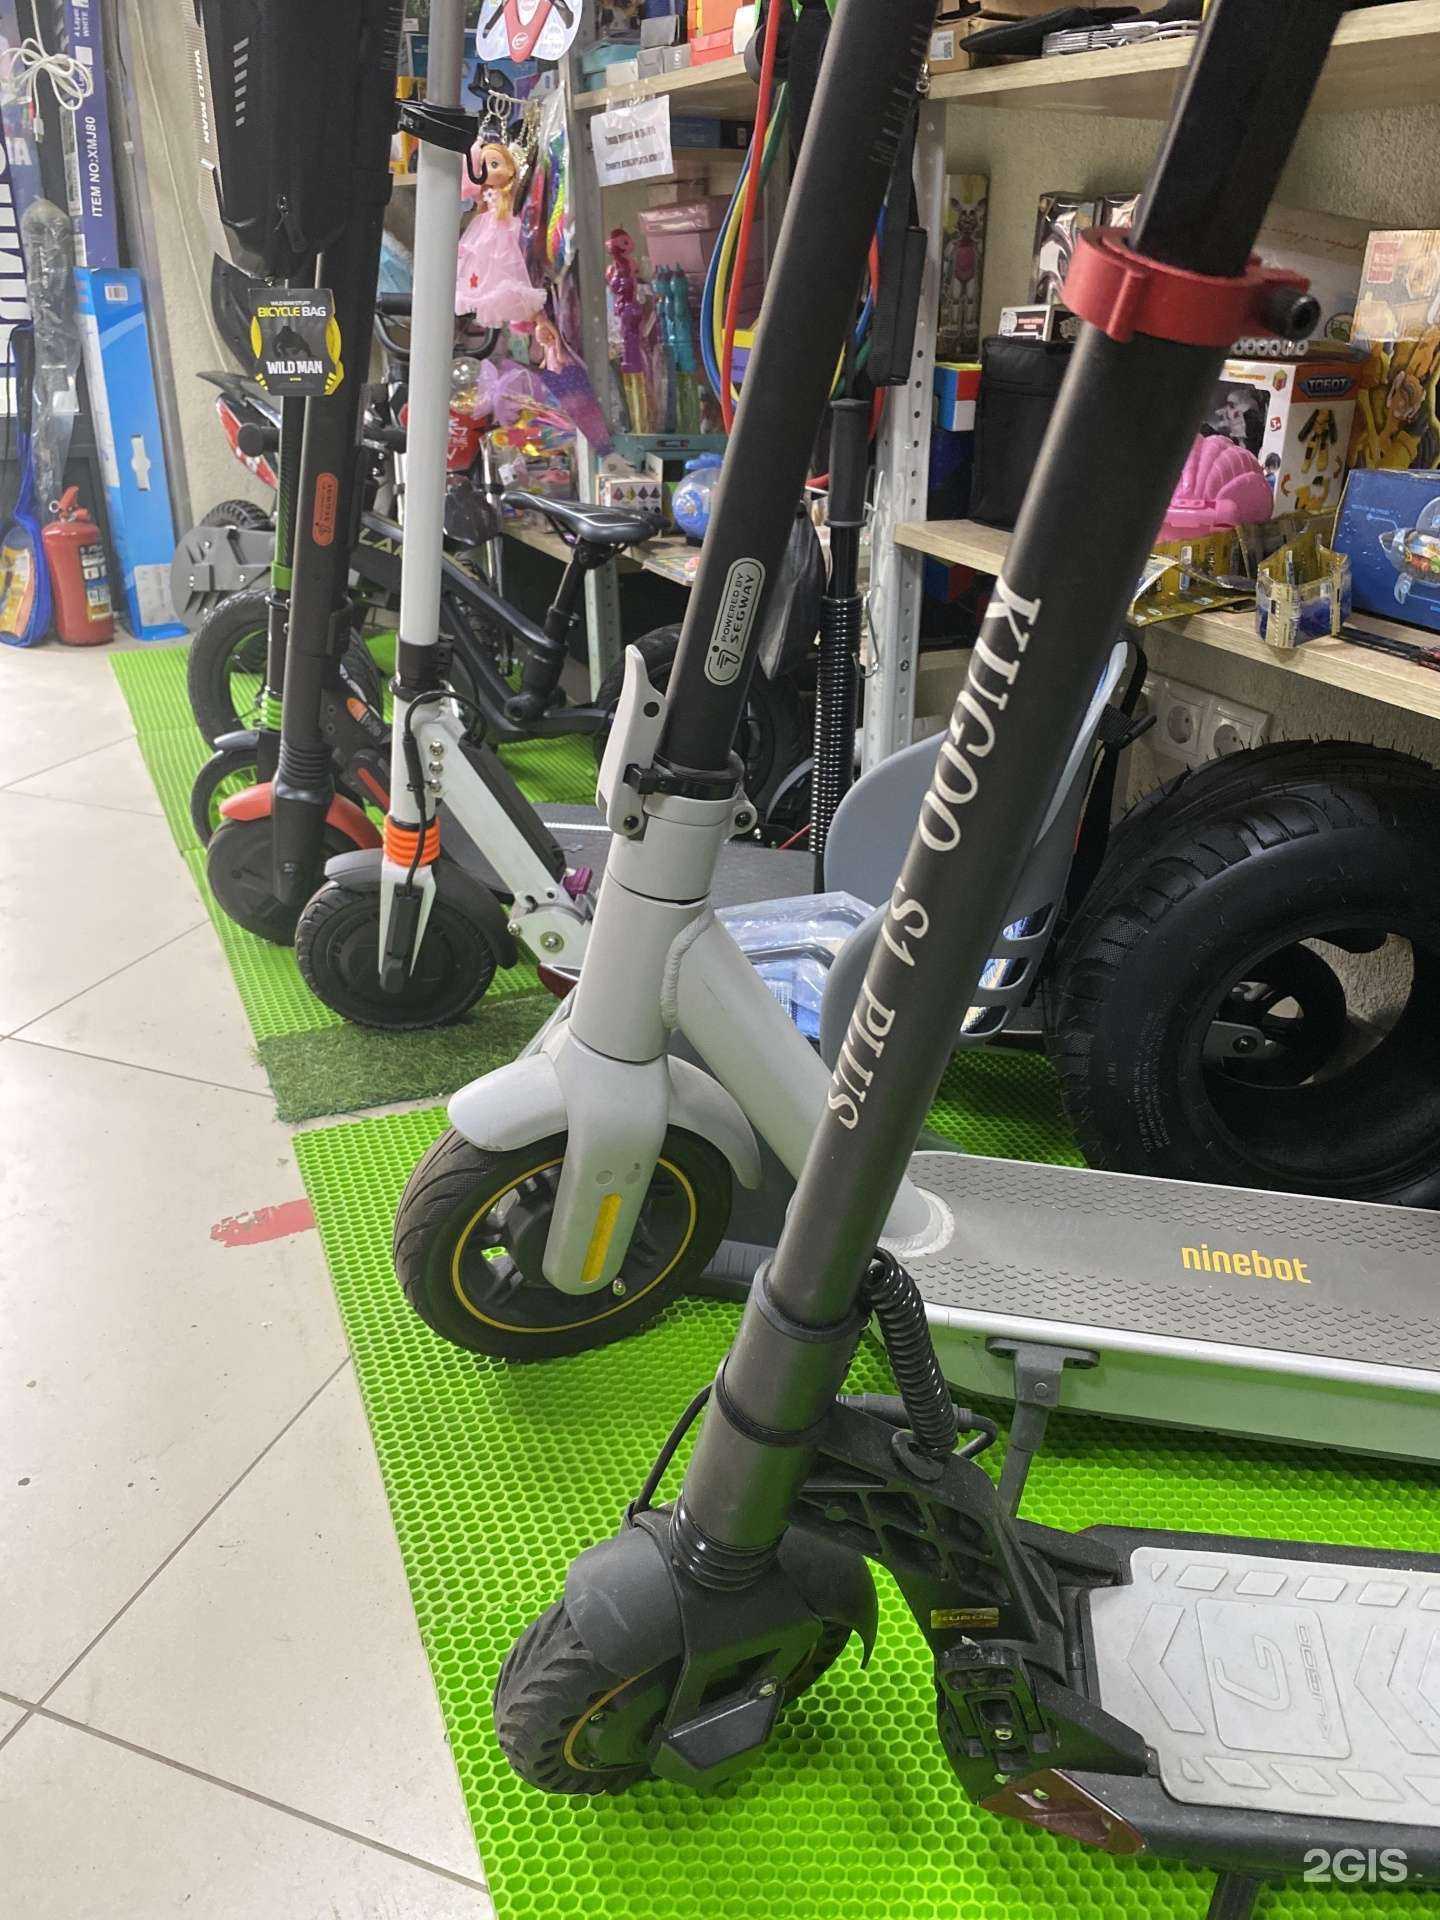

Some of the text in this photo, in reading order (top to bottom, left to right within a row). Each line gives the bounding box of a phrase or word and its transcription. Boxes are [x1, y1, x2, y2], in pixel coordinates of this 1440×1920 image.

[200, 101, 210, 144] MAN
[84, 116, 103, 217] ITEM NO:XMJ80
[257, 306, 327, 317] BICYCLE BAG
[266, 360, 324, 375] WILD MAN
[721, 572, 745, 642] POWERED BY
[730, 574, 755, 644] SEGWAY
[827, 576, 1041, 1131] KUGOO S1 PLUS
[1181, 1243, 1313, 1284] ninebot
